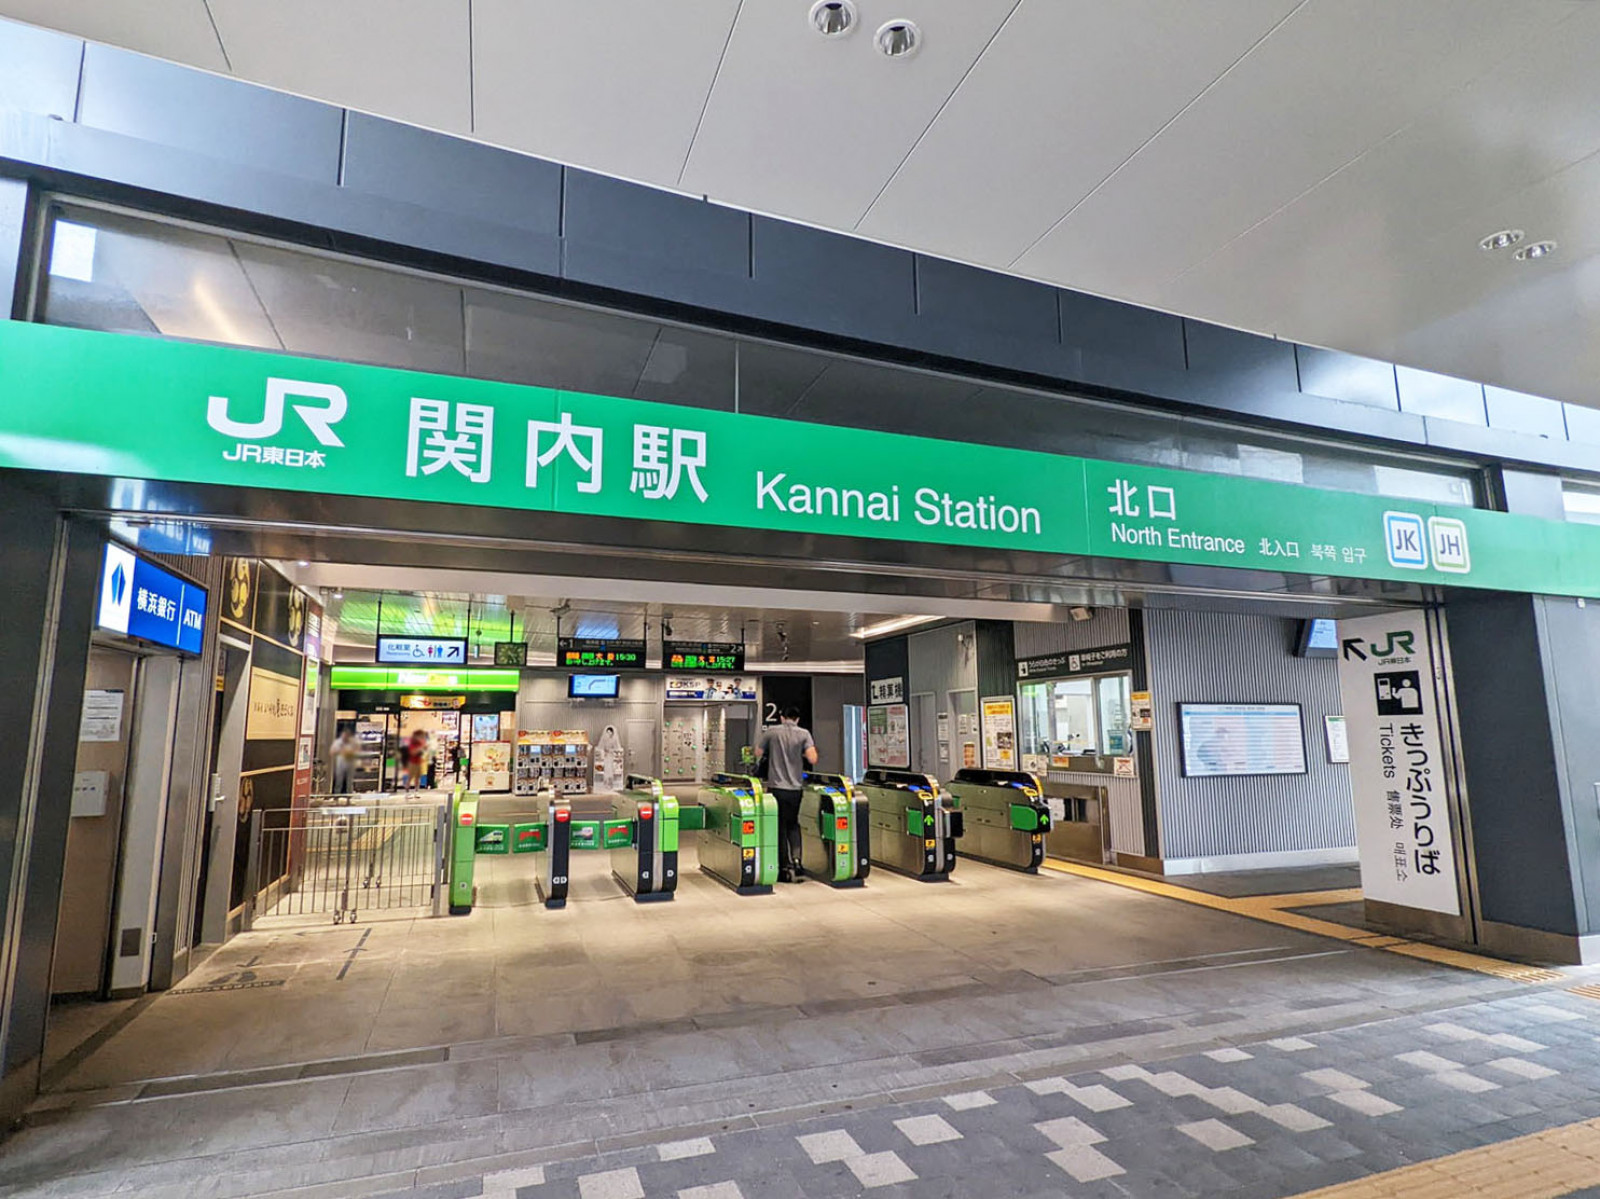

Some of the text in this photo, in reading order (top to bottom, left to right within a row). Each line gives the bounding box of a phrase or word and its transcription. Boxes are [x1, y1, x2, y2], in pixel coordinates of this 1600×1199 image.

[207, 377, 347, 447] JR
[222, 444, 327, 468] JR東日本
[406, 396, 709, 503] 関内駅
[756, 471, 1042, 534] Kannai Station
[1107, 479, 1177, 521] 北口
[1110, 522, 1246, 554] North Entrance
[1258, 537, 1300, 559] 北入口
[1395, 528, 1419, 552] JK
[1439, 533, 1461, 556] JH
[1310, 543, 1367, 564] 북쪽 입구
[137, 587, 176, 622] 横浜銀行
[183, 608, 203, 630] ATM
[1370, 630, 1416, 657] JR
[1378, 656, 1412, 666] JR東日本
[765, 702, 778, 722] 2
[1379, 722, 1395, 779] Tickets
[1400, 722, 1441, 875] きっぷうりば
[1393, 842, 1408, 882] 매표소
